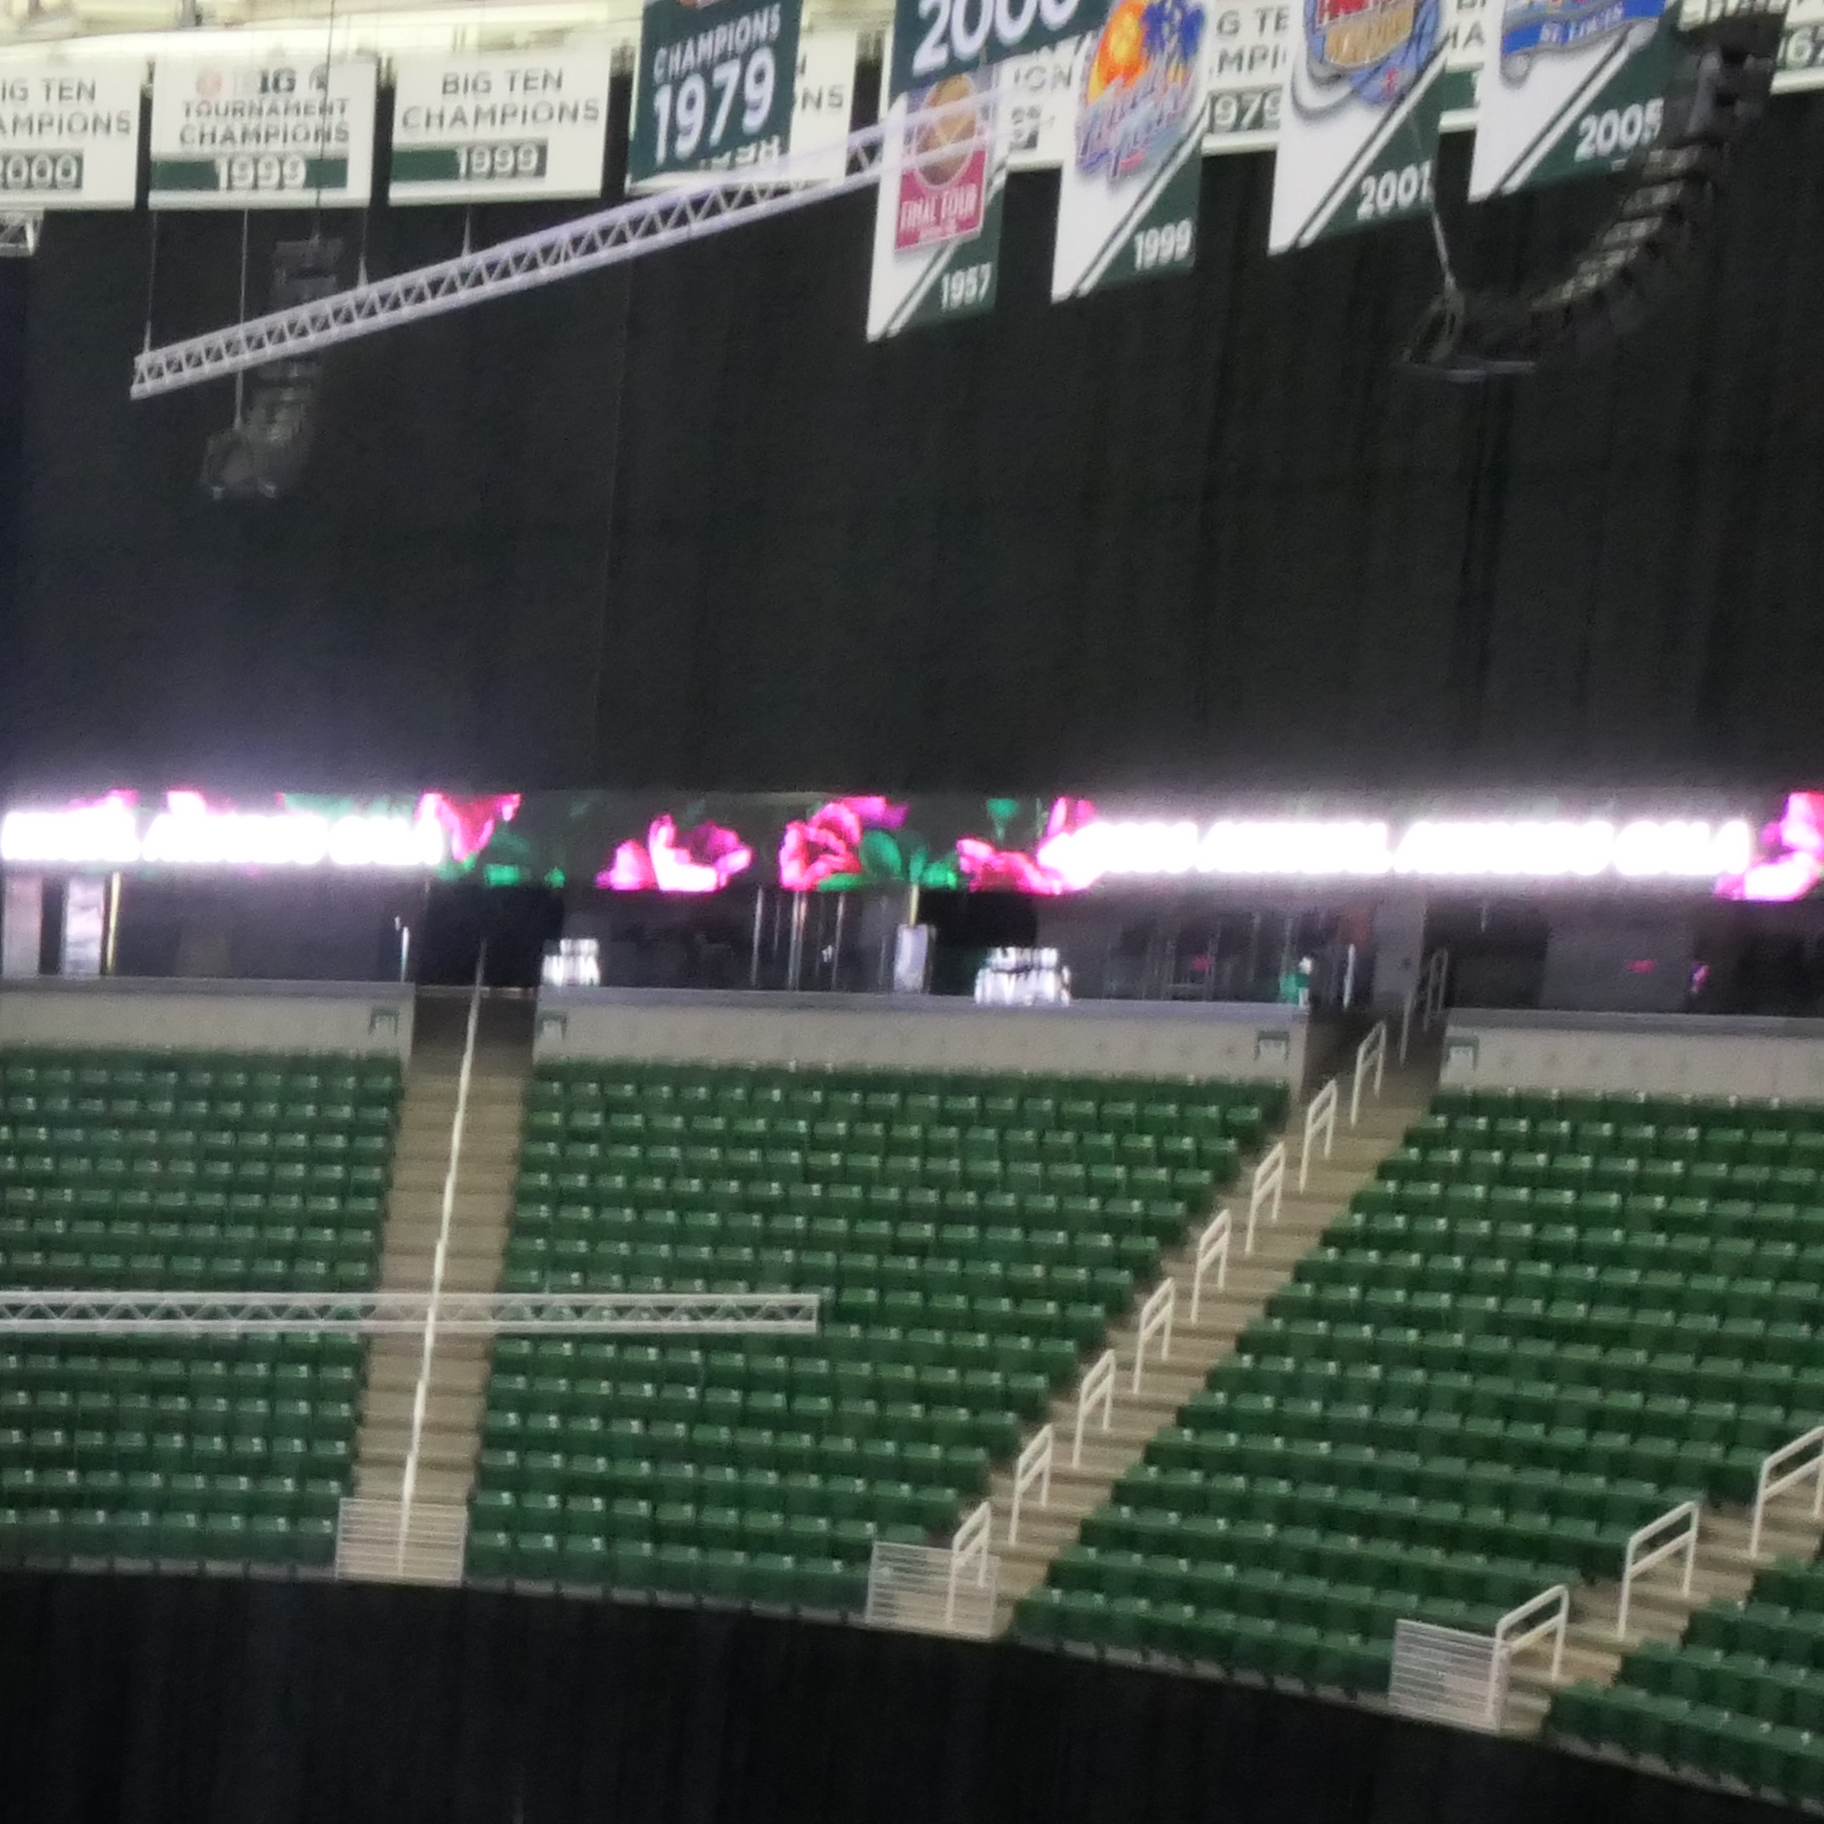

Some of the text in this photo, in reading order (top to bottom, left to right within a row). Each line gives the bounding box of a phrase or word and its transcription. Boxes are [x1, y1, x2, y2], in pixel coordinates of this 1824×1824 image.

[1255, 5, 1290, 36] TE
[653, 3, 782, 85] CHAMPIONS
[41, 78, 96, 105] TEN
[442, 67, 565, 97] BIG TEN
[182, 98, 349, 120] TOURNAMENT
[401, 99, 600, 132] CHAMPIONS
[653, 46, 776, 168] 1979
[179, 121, 350, 148] CHAMPIONS
[215, 153, 306, 190] 1999
[457, 144, 540, 181] 1999
[1356, 158, 1432, 221] 2001
[1135, 217, 1193, 271] 1999
[940, 262, 992, 311] 1957
